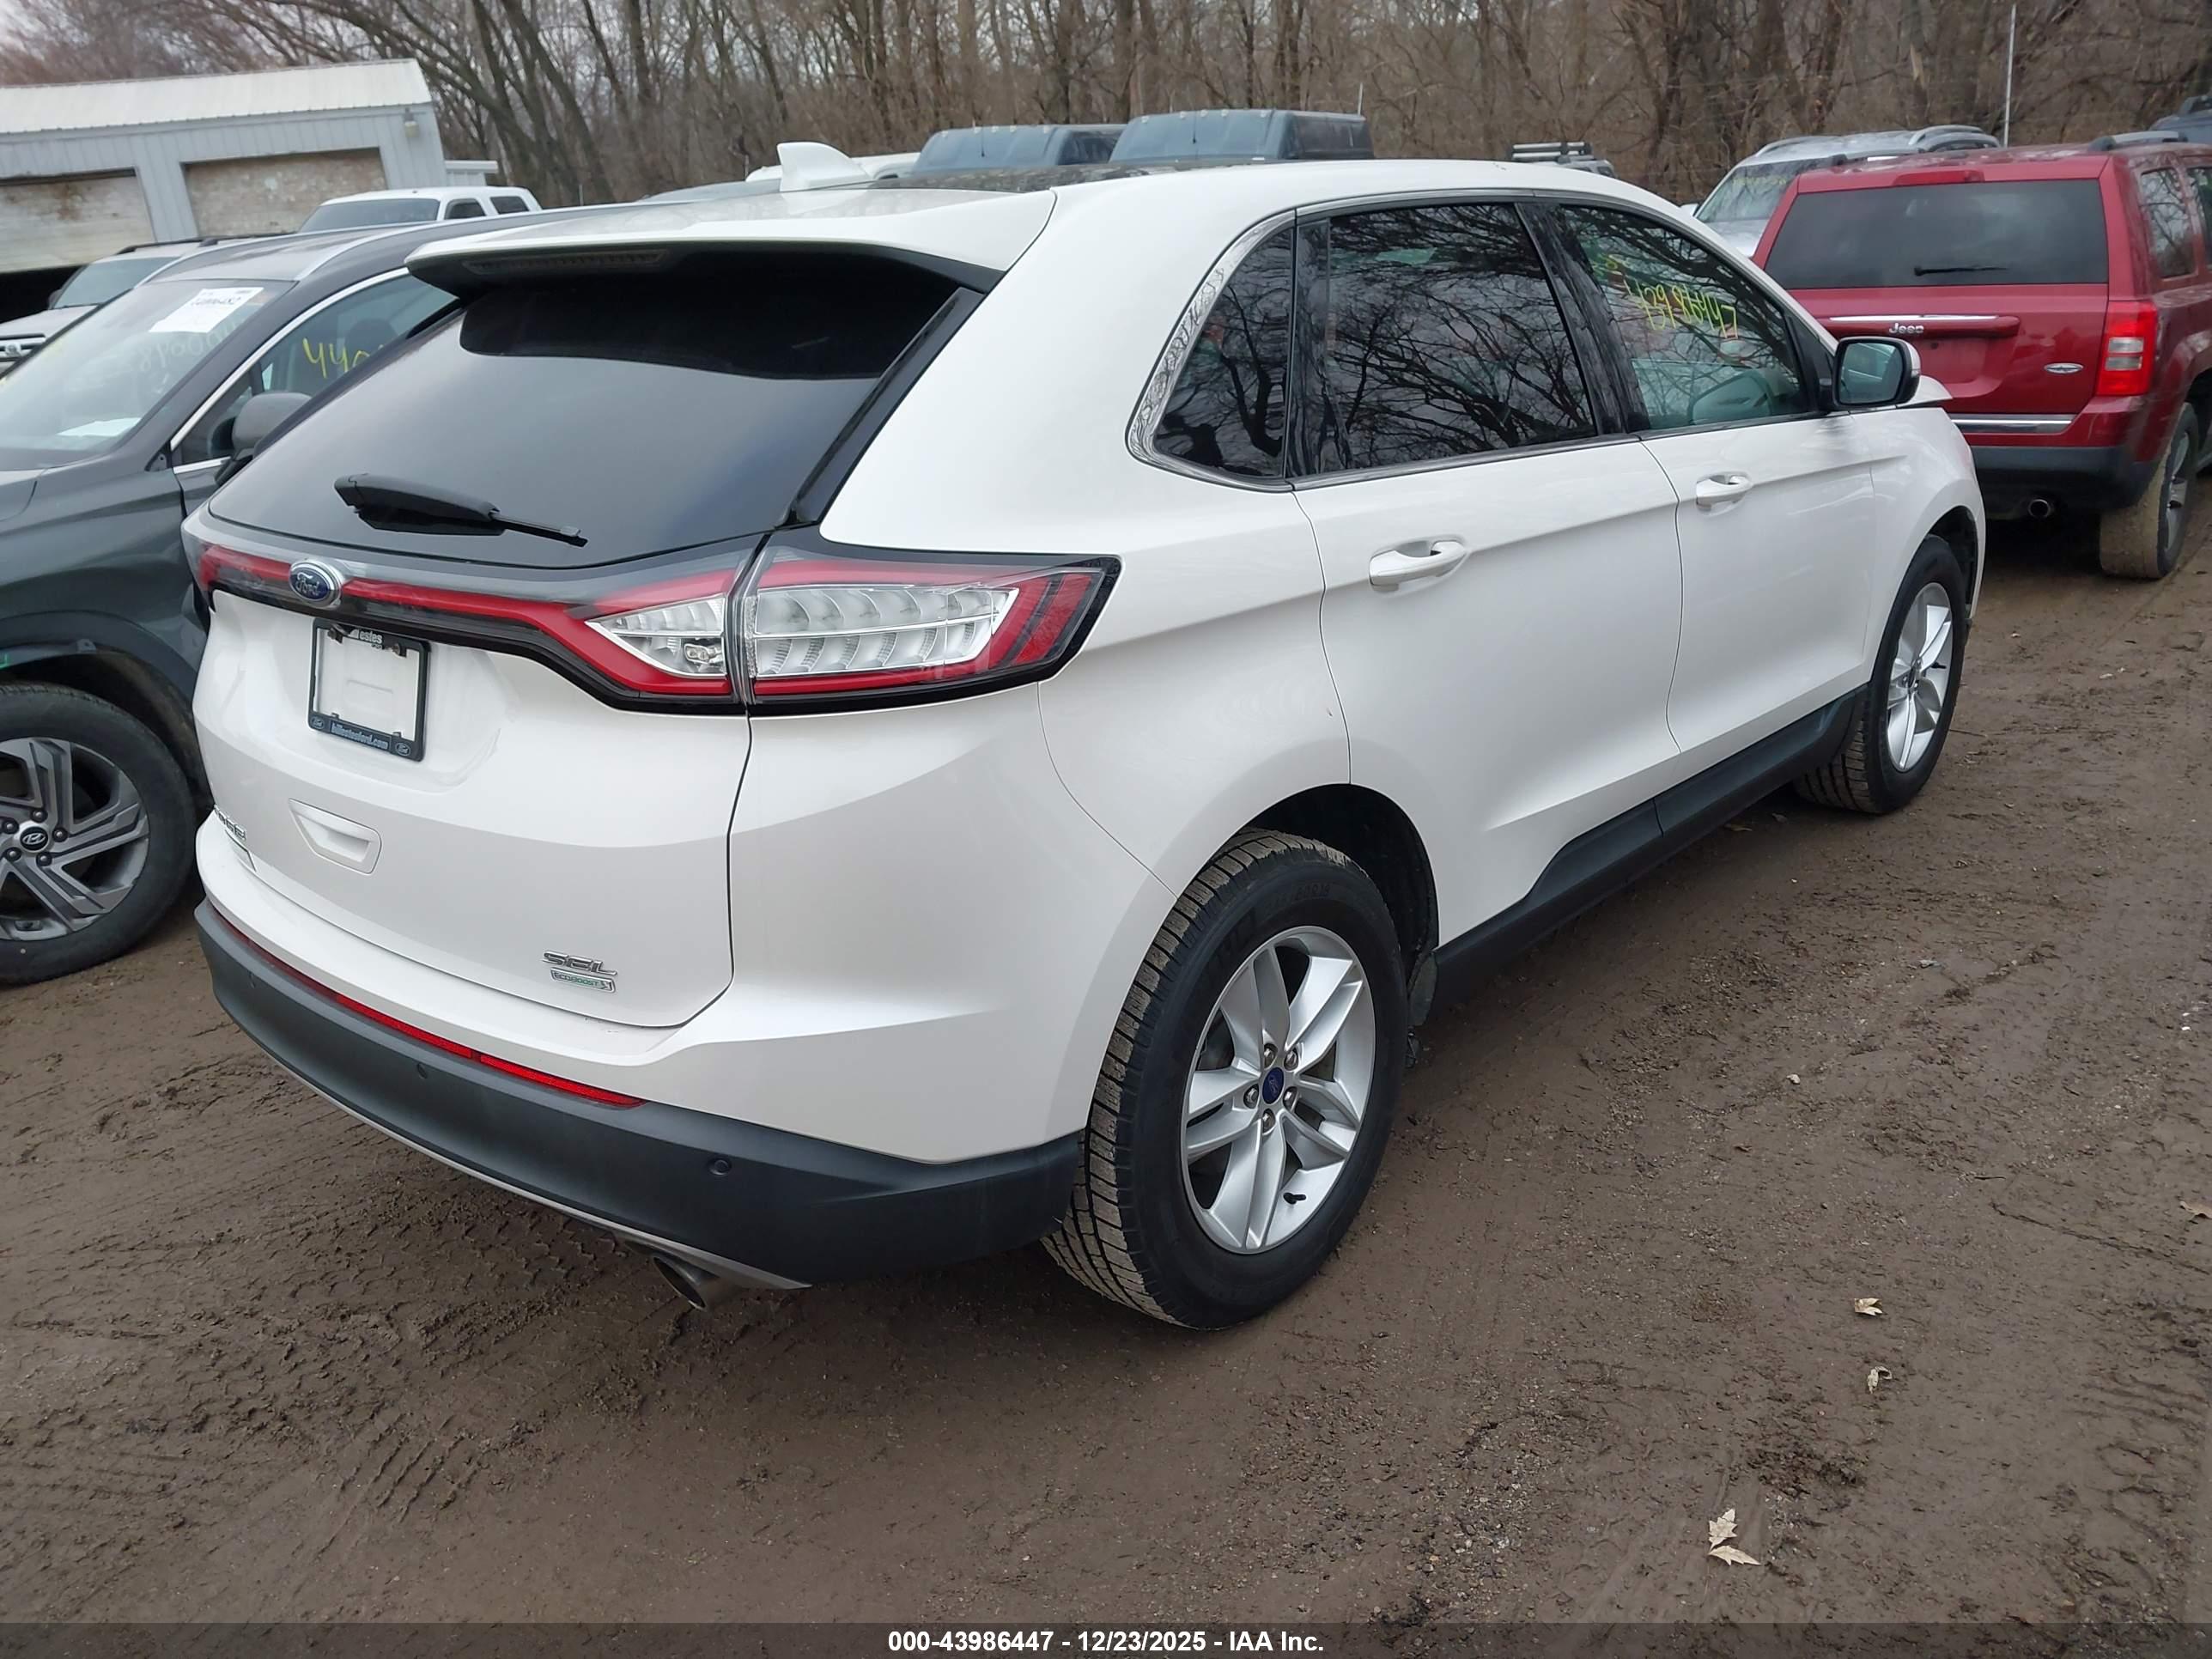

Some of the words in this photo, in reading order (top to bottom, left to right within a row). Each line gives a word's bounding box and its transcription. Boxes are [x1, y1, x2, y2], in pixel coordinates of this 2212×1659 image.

[1888, 322, 1924, 334] Jeep
[295, 571, 320, 596] Ford
[359, 629, 383, 644] estes
[542, 950, 618, 976] SEL
[553, 971, 599, 988] ECOBOOST
